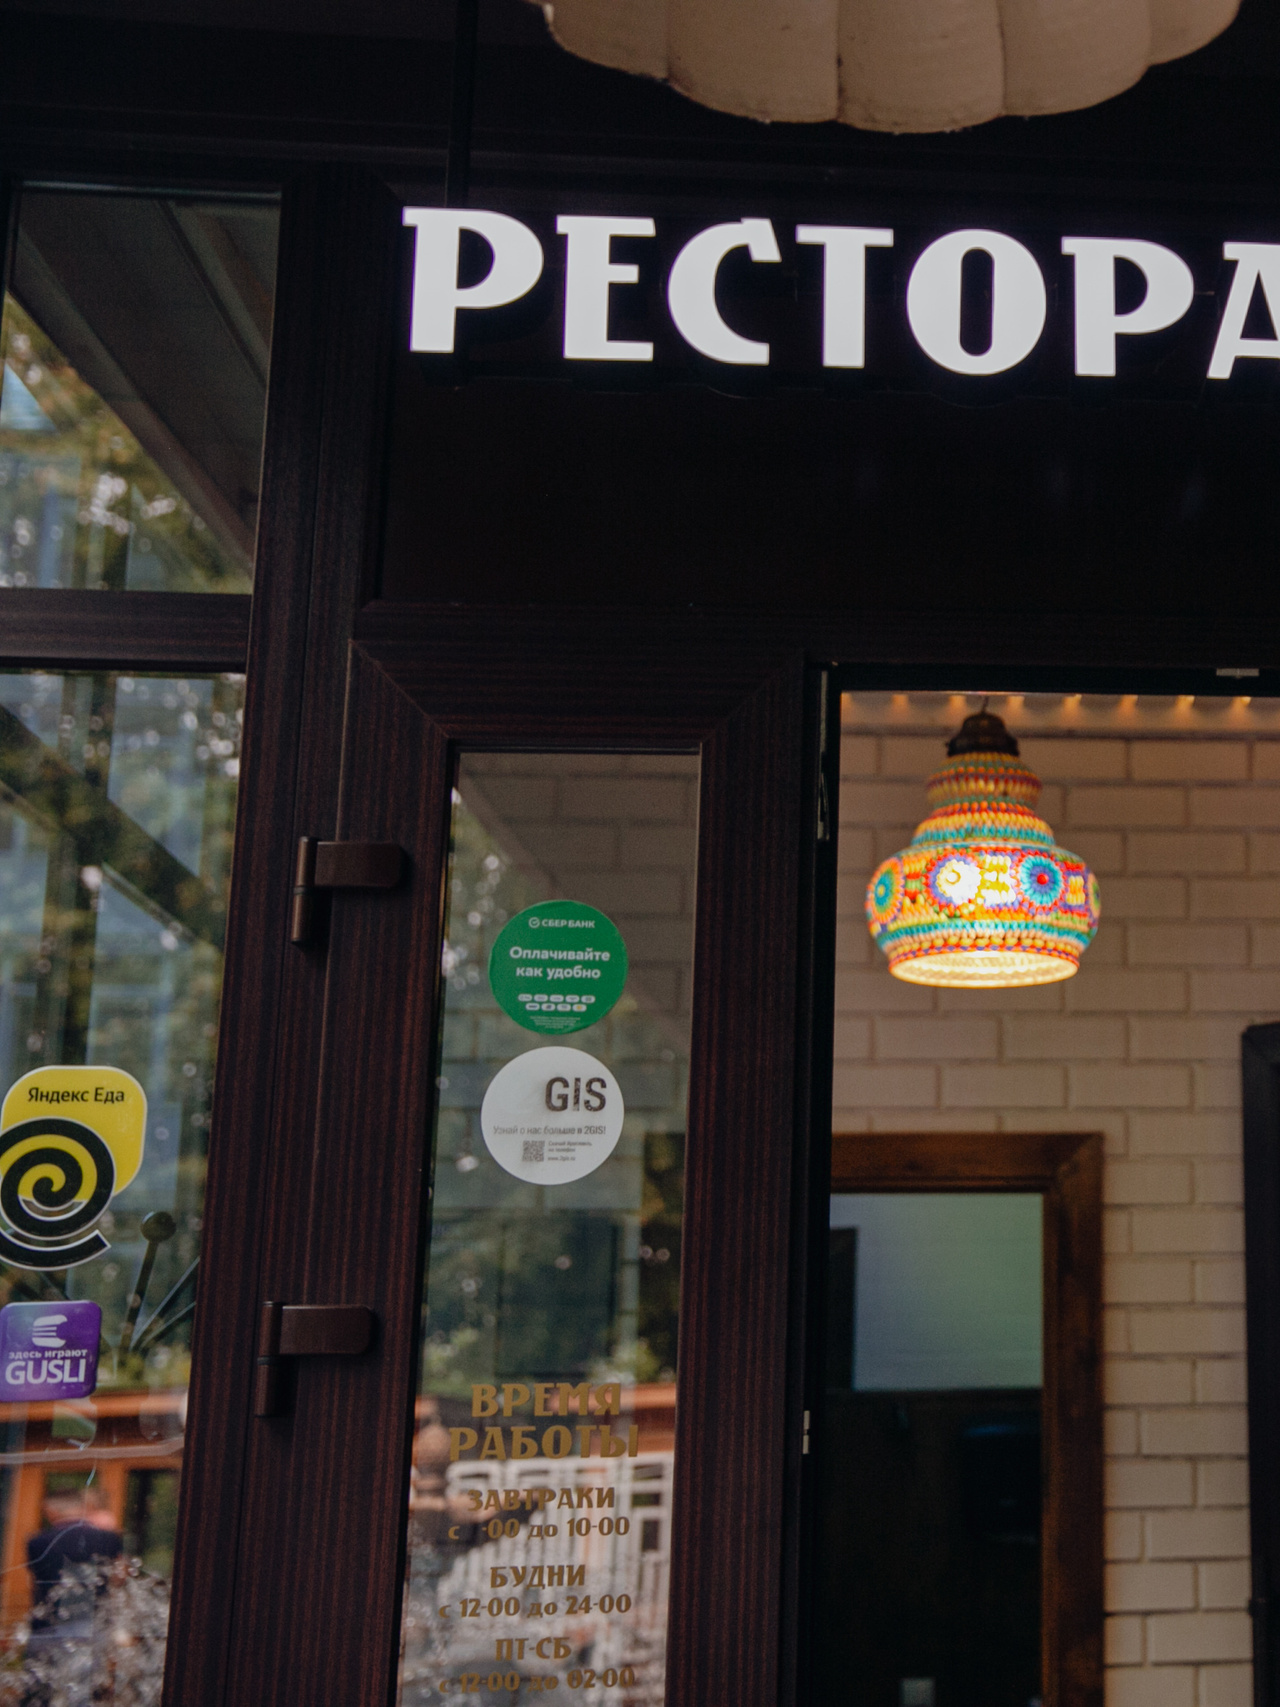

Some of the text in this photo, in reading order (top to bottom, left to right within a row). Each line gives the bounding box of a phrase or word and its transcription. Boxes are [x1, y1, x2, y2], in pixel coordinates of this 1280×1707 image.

[509, 946, 611, 961] Оплачивайте
[516, 965, 601, 980] как удобно
[28, 1086, 125, 1104] Яндекс Еда
[545, 1076, 607, 1112] GIS
[9, 1348, 88, 1360] здесь играют
[5, 1358, 87, 1385] GUSLI
[471, 1382, 621, 1417] ВРЕМЯ
[448, 1425, 638, 1463] РАБОТЫ
[467, 1487, 615, 1511] ЗАВТРАКИ
[448, 1526, 460, 1540] с
[527, 1524, 558, 1540] до
[566, 1516, 630, 1537] 10-00
[490, 1564, 586, 1590] БУДНИ
[438, 1593, 632, 1618] с 12-00 до 24-00
[495, 1636, 572, 1661] ПТ-СБ
[438, 1667, 635, 1694] с 12-00 до 02-00
